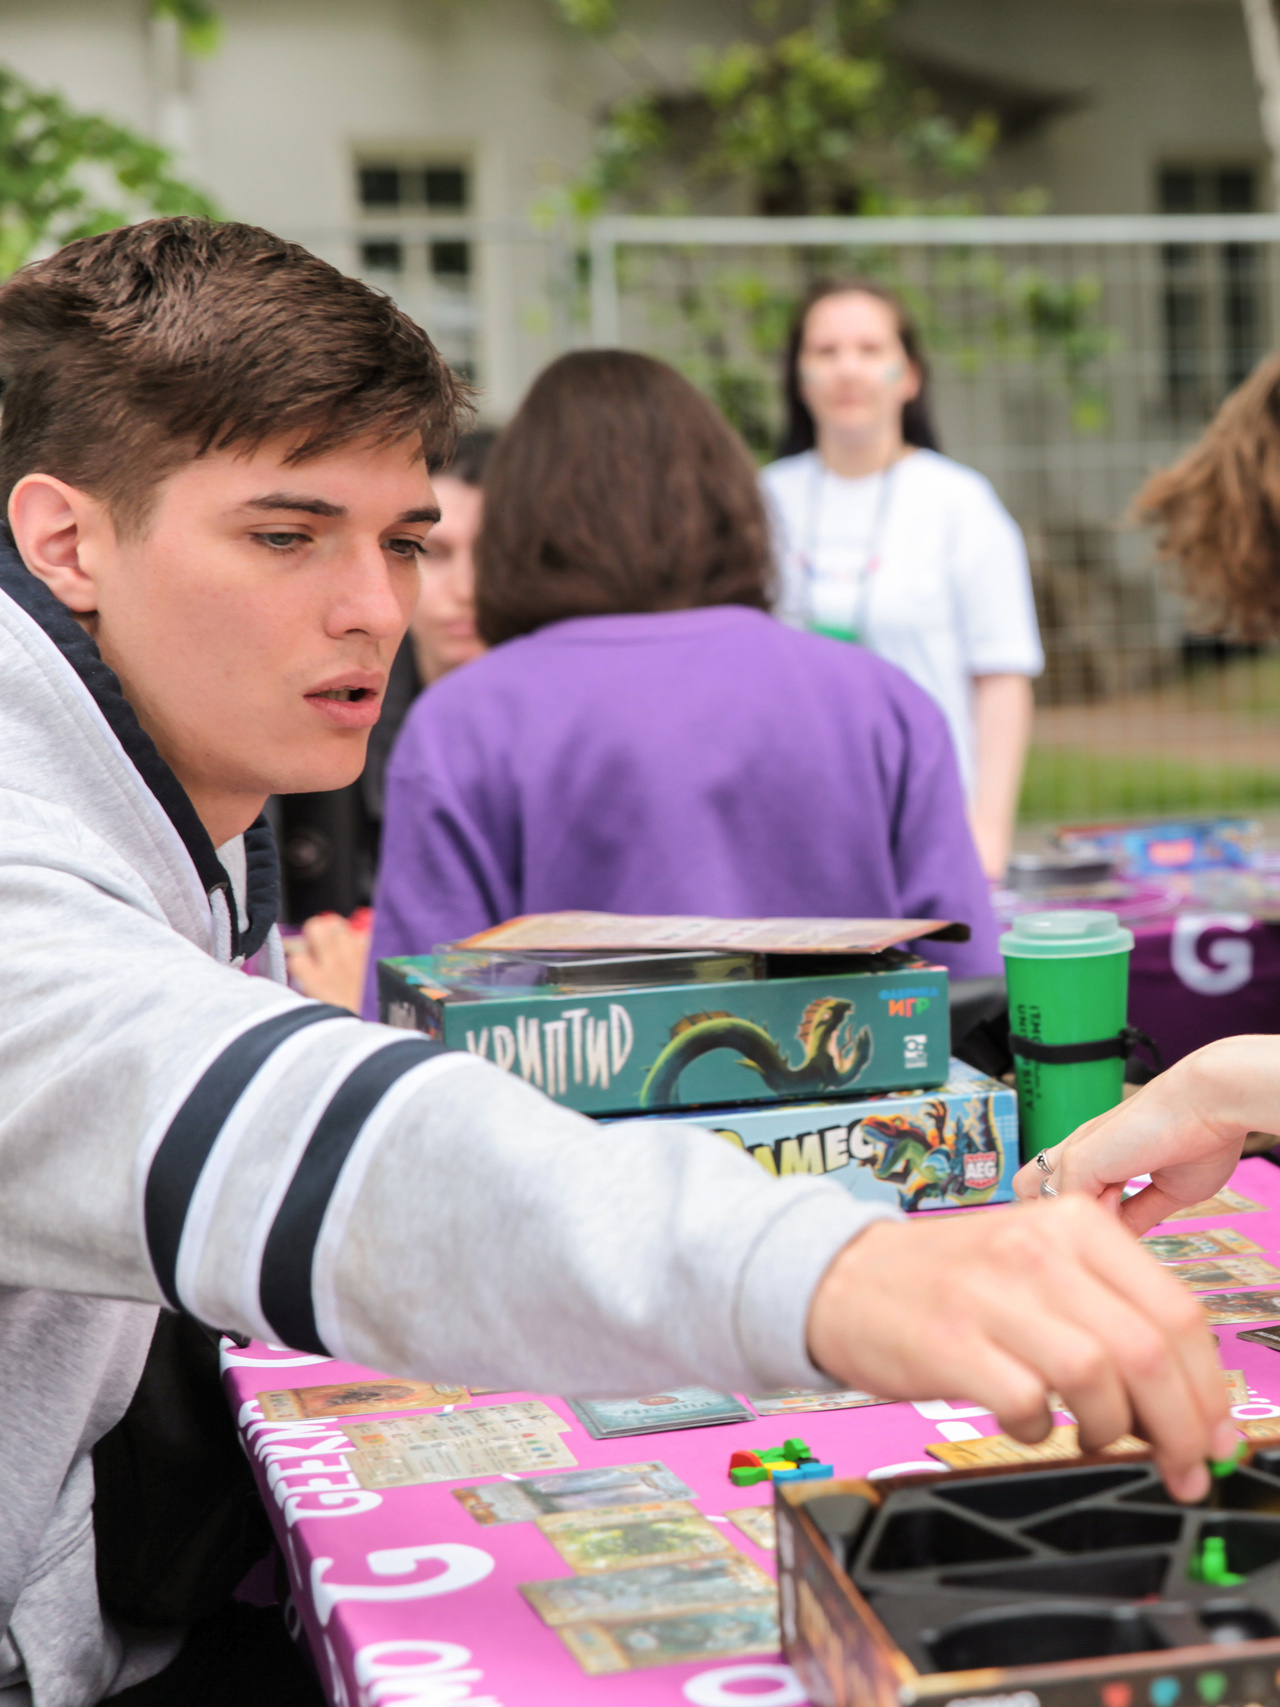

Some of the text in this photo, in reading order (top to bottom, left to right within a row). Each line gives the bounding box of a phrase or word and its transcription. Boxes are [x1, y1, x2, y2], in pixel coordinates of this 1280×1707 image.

[1170, 912, 1253, 996] G
[889, 997, 930, 1017] ИГР
[965, 1160, 997, 1180] AEG
